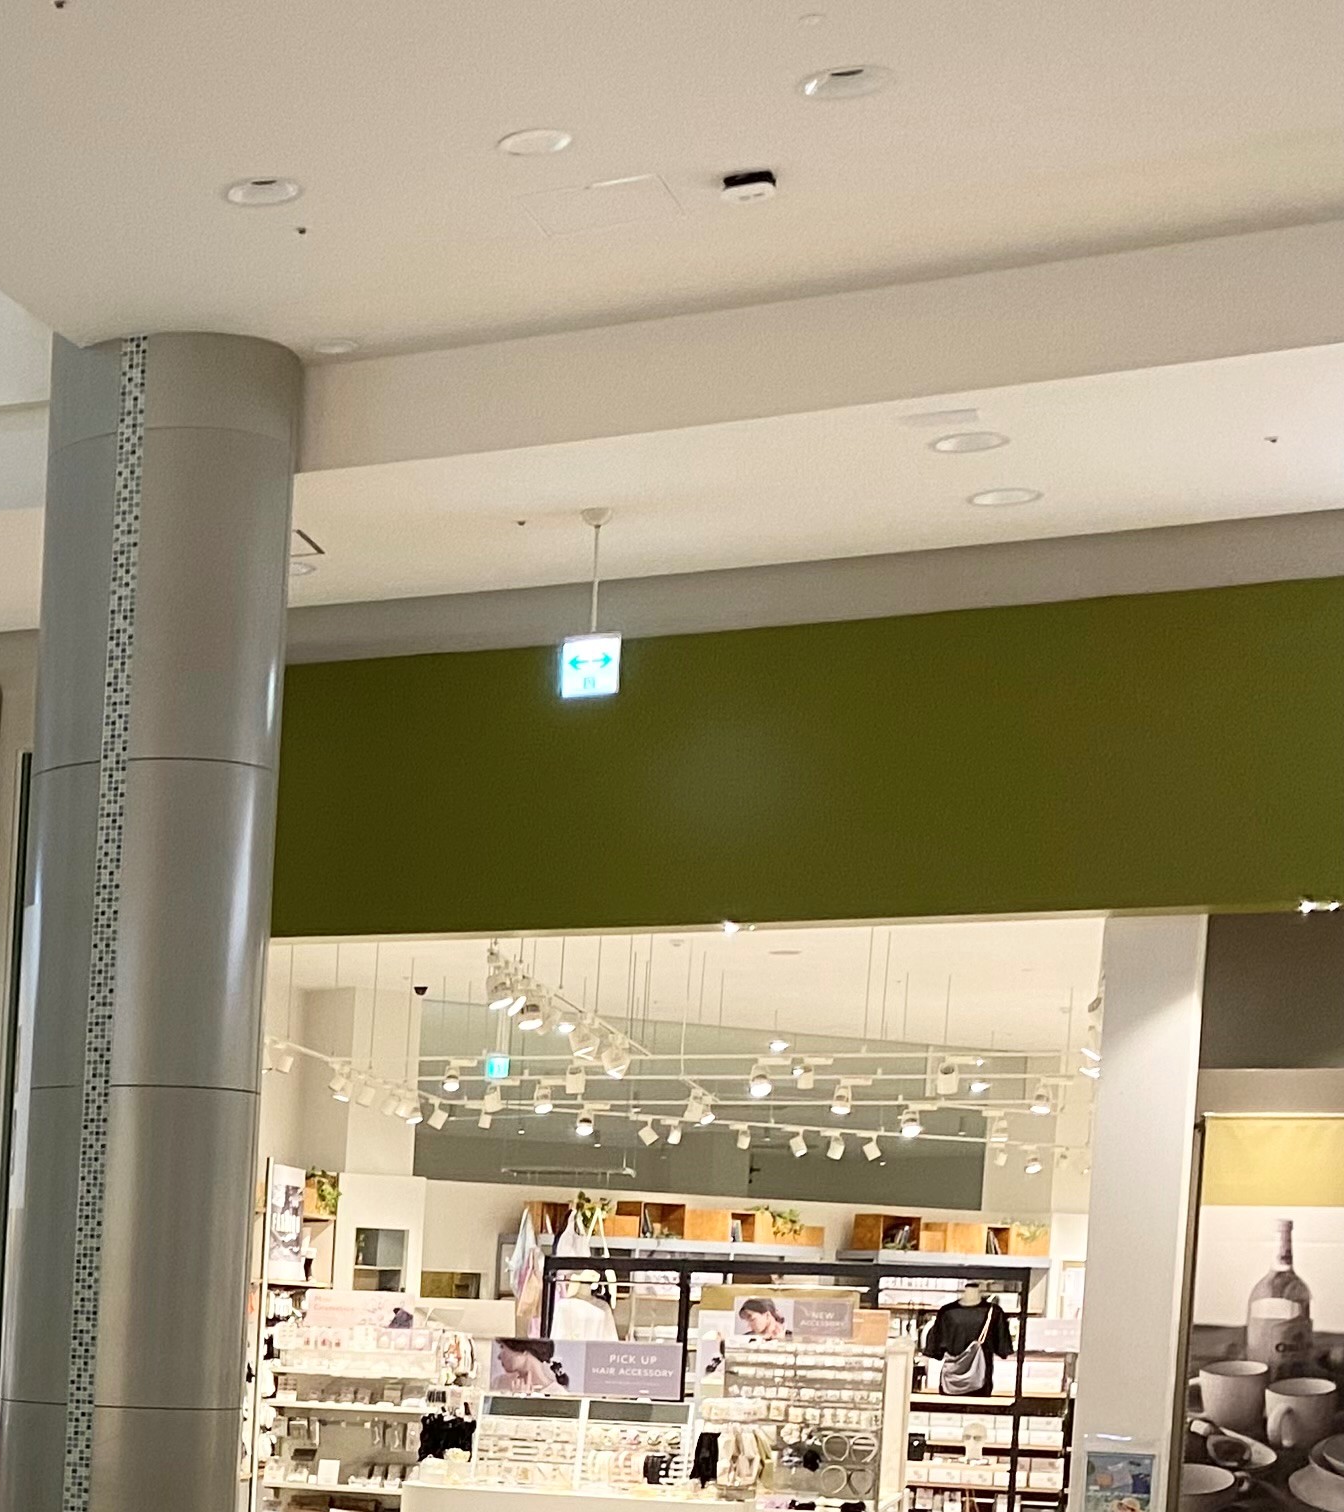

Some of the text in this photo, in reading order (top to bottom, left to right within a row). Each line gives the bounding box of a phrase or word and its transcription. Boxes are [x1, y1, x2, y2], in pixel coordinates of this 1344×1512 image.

[812, 1311, 836, 1320] NEW
[609, 1354, 658, 1365] PICK UP
[592, 1366, 674, 1378] HAIR ACCESSORY
